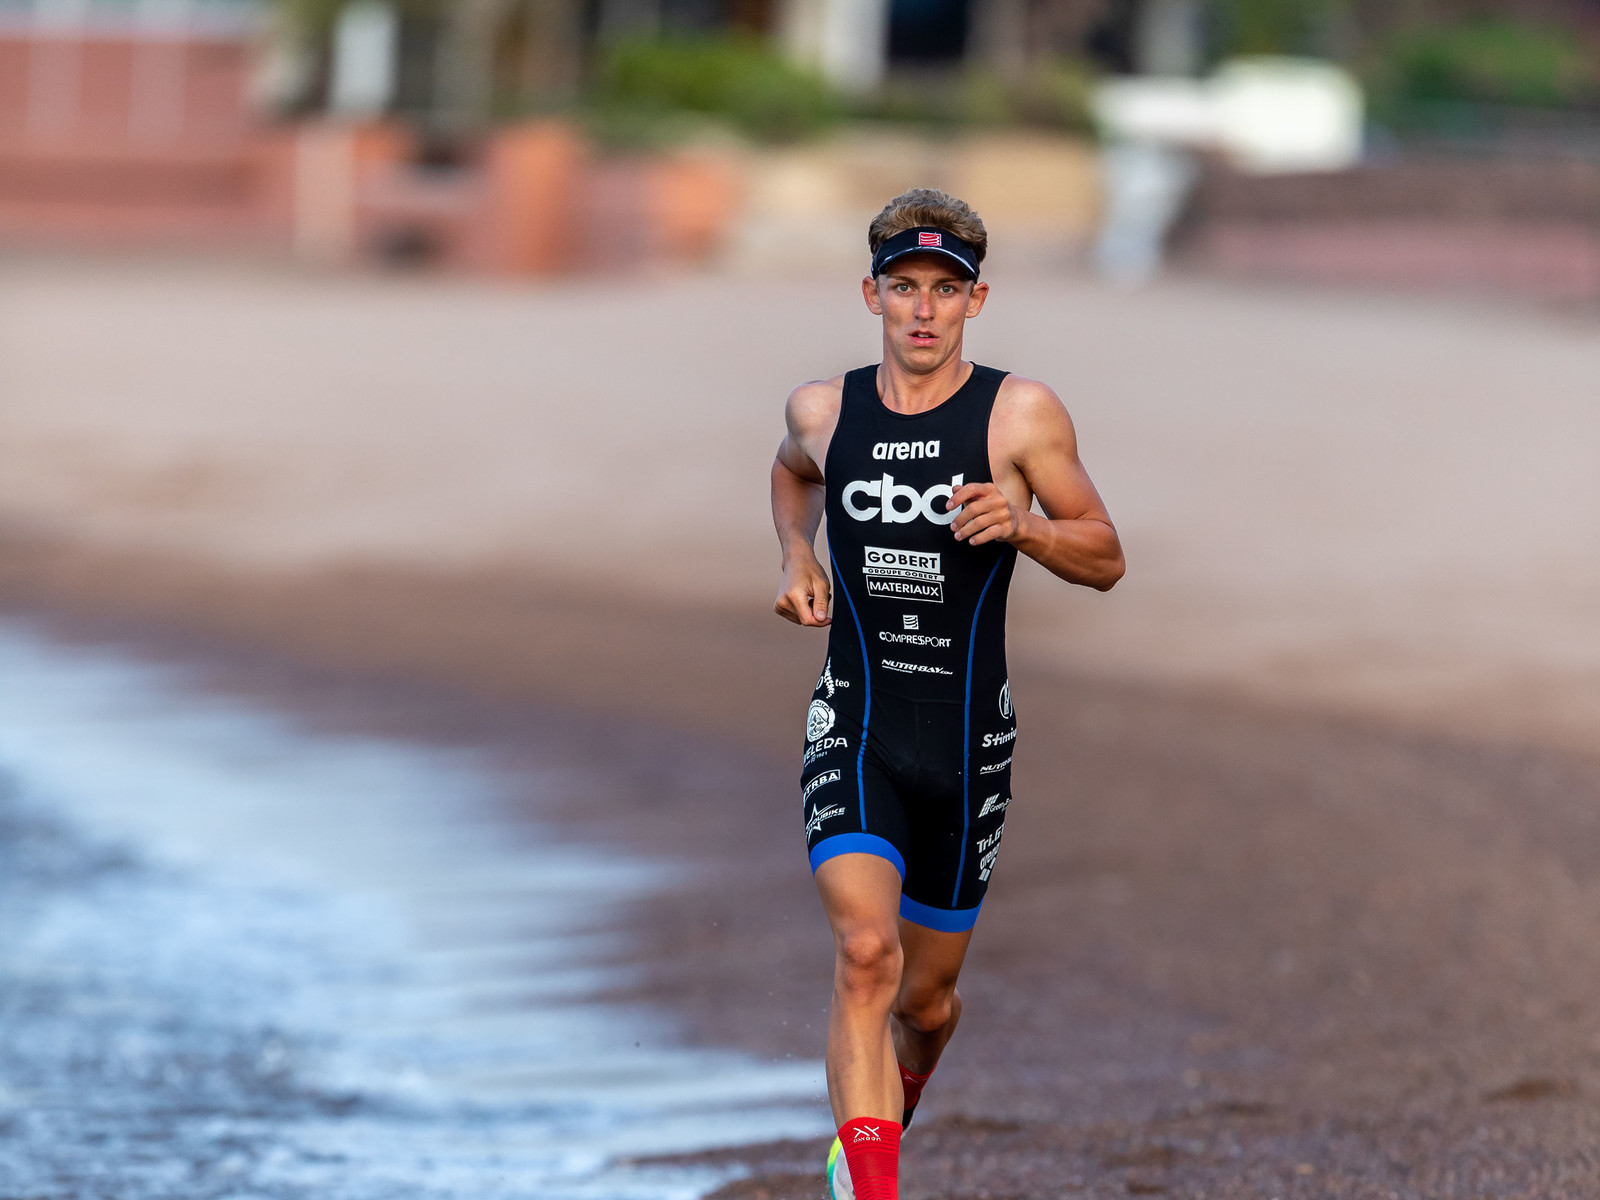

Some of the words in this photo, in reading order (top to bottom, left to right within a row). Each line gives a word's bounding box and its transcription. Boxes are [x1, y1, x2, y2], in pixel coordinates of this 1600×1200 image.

[872, 440, 940, 460] arena
[842, 472, 964, 525] cbd
[867, 551, 938, 569] GOBERT
[868, 568, 901, 576] GROUPE
[905, 571, 938, 581] GOBERT
[869, 581, 939, 597] MATERIAUX
[804, 737, 848, 765] ELEDA
